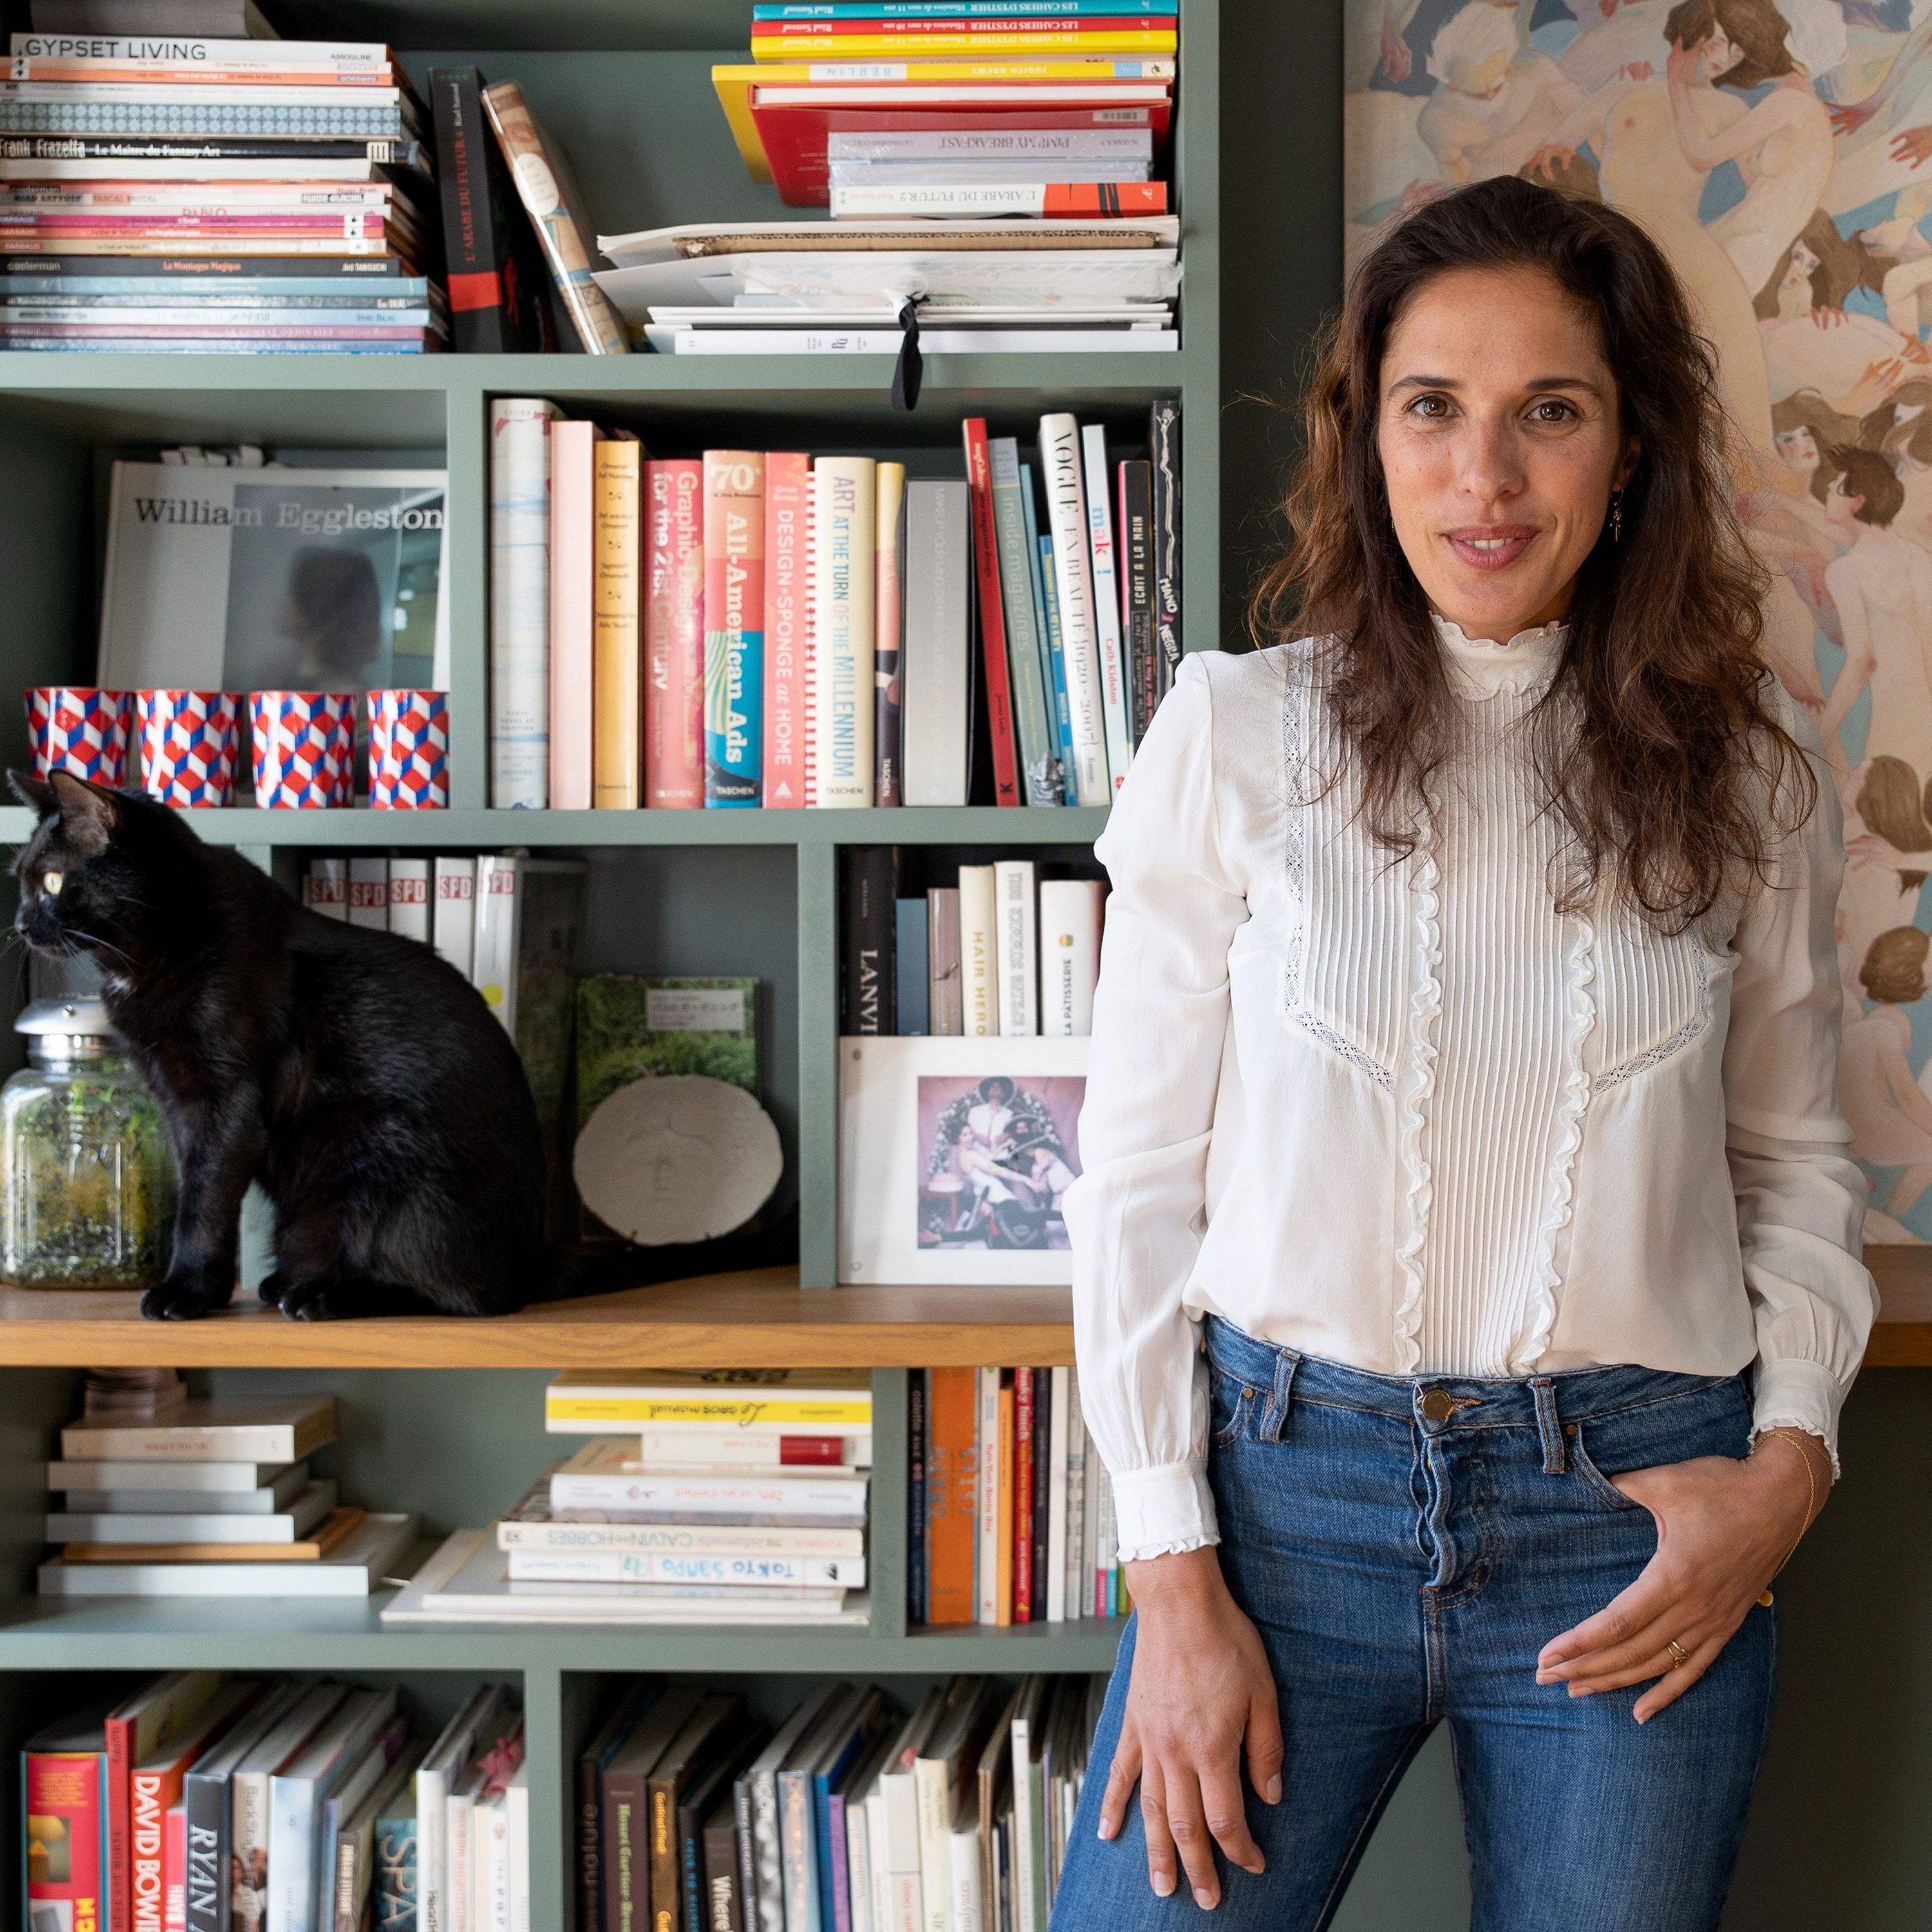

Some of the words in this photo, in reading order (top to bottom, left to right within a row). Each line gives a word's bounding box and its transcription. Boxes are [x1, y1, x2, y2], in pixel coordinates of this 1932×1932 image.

[1019, 3, 1060, 12] CAHIERS
[1062, 3, 1078, 12] LES
[1019, 21, 1060, 30] CAHIERS
[1062, 21, 1079, 30] LES
[26, 39, 118, 57] GYPSET
[129, 43, 206, 60] LIVING
[827, 67, 891, 76] BERLIN
[37, 139, 86, 158] Frazetta
[203, 145, 221, 156] Art
[938, 137, 1014, 149] BREAKFAST
[900, 192, 907, 202] 2
[909, 192, 953, 202] FUTUR
[959, 192, 978, 201] DU
[982, 191, 1036, 201] L'ARABE
[7, 261, 60, 270] casterman
[1054, 431, 1079, 515] VOGUE
[654, 473, 672, 504] for
[833, 477, 855, 513] ART
[135, 498, 263, 528] William
[277, 502, 444, 535] Eggleston
[676, 472, 697, 559] Graphic
[833, 516, 849, 531] AT
[1003, 497, 1021, 549] inside
[654, 510, 672, 547] the
[1064, 527, 1081, 551] EN
[1132, 516, 1144, 540] MAIN
[833, 535, 849, 560] THE
[1133, 545, 1144, 558] LA
[833, 564, 849, 600] TURN
[676, 567, 697, 644] Design
[1006, 554, 1030, 650] magazines
[1066, 559, 1089, 632] BEAUTÉ
[1159, 578, 1179, 613] MANO
[725, 513, 748, 706] All-American
[833, 605, 849, 621] OF
[833, 627, 849, 652] THE
[1105, 639, 1116, 662] Cath
[1159, 624, 1180, 661] NEGRA
[1107, 665, 1119, 705] Kidston
[833, 656, 855, 777] MILLENNIUM
[725, 711, 748, 763] Ads
[775, 710, 793, 765] HOME
[716, 786, 755, 795] TASCHEN
[882, 759, 892, 798] TASCHEN
[352, 884, 386, 906] SPD
[392, 880, 426, 902] SPD
[440, 876, 471, 898] SPD
[1007, 873, 1023, 900] 2011
[1009, 907, 1024, 970] SUMMER
[974, 932, 985, 978] HAIR
[860, 950, 878, 1032] LANVI
[1009, 974, 1025, 1027] SPRING
[1061, 959, 1072, 1018] PÂTISSERIE
[1063, 1022, 1072, 1036] LA
[649, 1405, 701, 1418] manuel
[703, 1406, 737, 1414] GROS
[739, 1402, 766, 1426] Le
[548, 1530, 612, 1545] HOBBES
[630, 1532, 692, 1547] CALVIN
[134, 1776, 162, 1857] DAVID
[189, 1823, 218, 1918] RYAN
[380, 1834, 419, 1925] SPA
